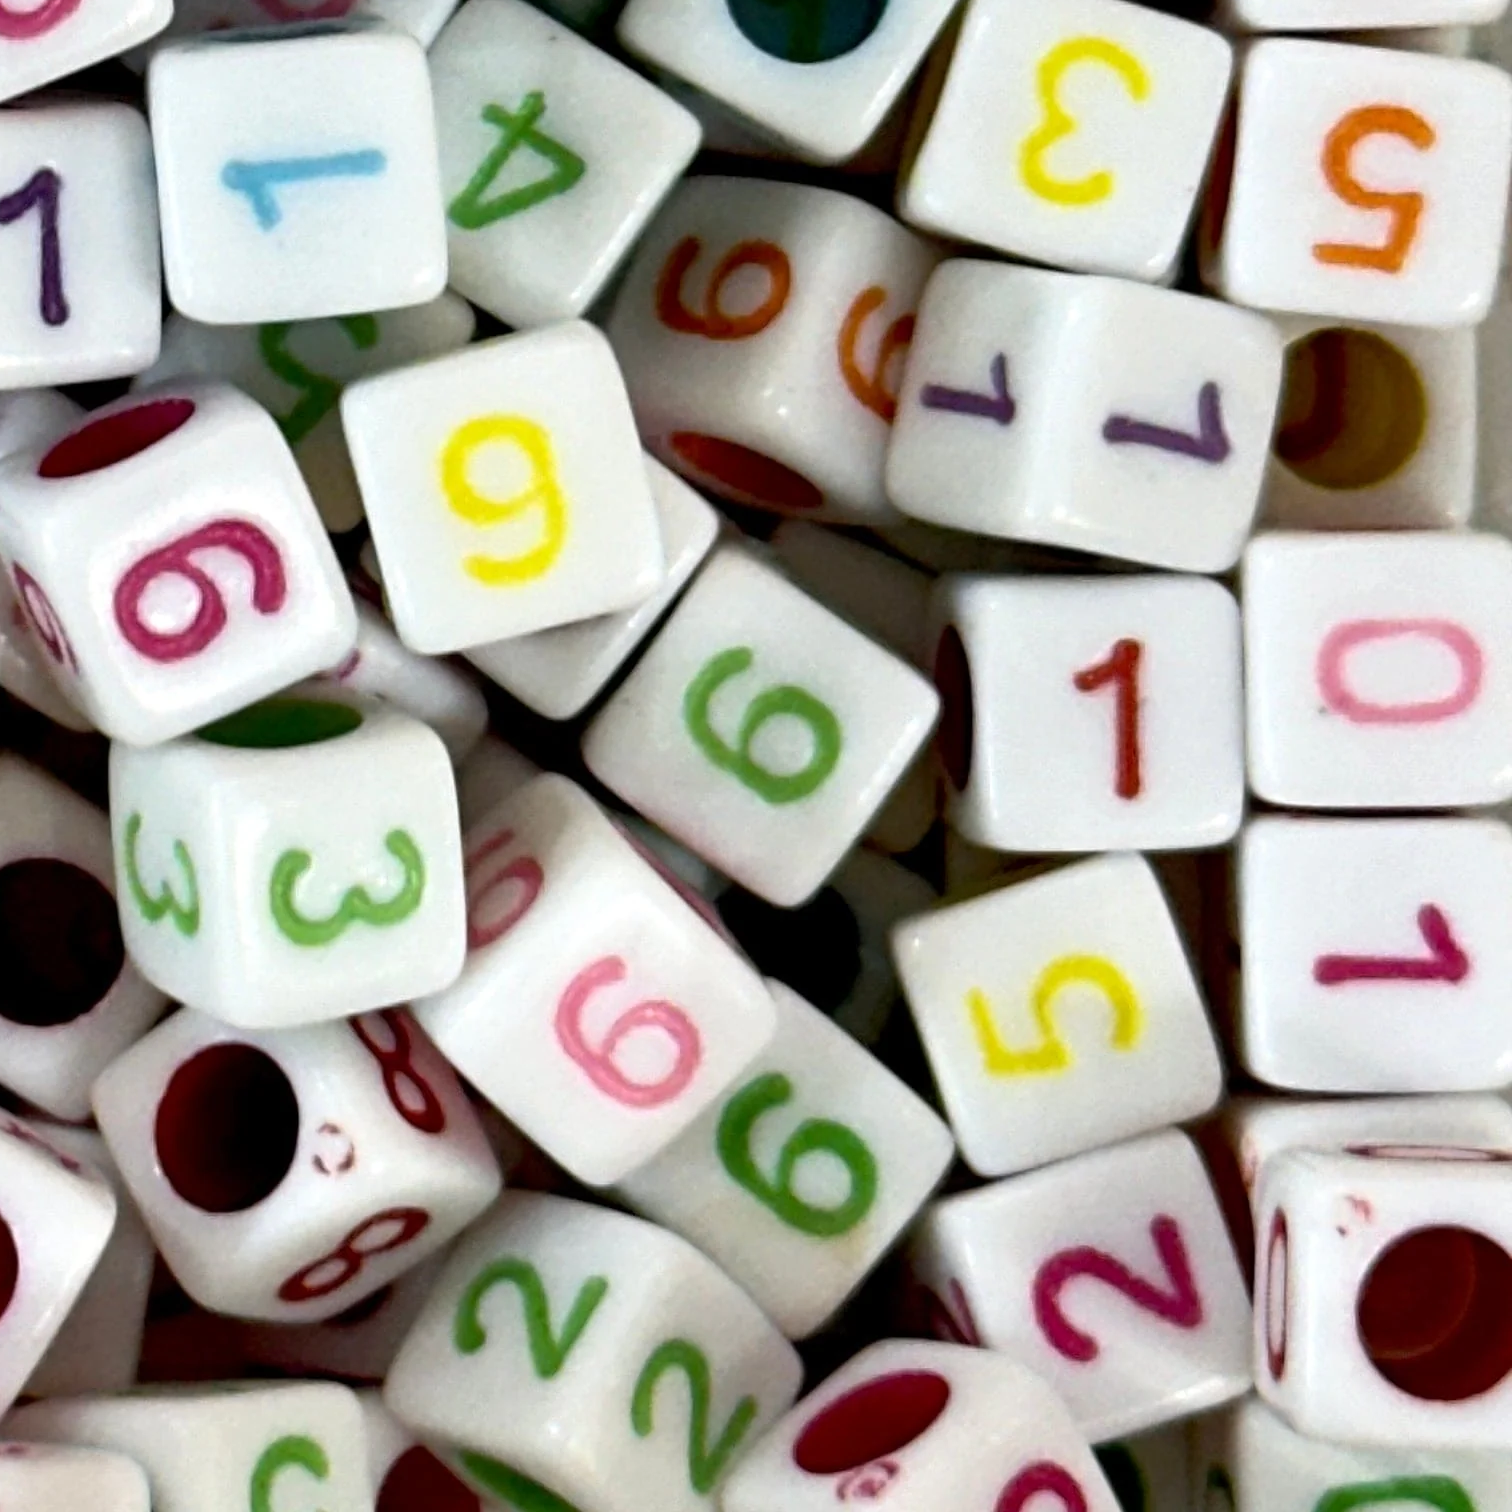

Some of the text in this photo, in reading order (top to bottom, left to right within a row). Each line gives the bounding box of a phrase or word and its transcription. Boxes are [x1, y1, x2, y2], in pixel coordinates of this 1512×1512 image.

[451, 93, 583, 229] 4
[1017, 35, 1152, 210] 3
[219, 149, 387, 235] 1
[1316, 106, 1434, 272] 5
[1101, 377, 1232, 465] 1
[687, 650, 840, 802] 6
[1073, 640, 1143, 799] 1
[1322, 625, 1480, 721] 0
[127, 818, 198, 934] 3
[271, 831, 425, 947] 3
[1313, 902, 1473, 987] 1
[558, 961, 697, 1104] 6
[965, 953, 1146, 1080] 5
[719, 1076, 877, 1239] 6
[281, 1211, 427, 1300] 8
[457, 1262, 604, 1377] 2
[1034, 1218, 1201, 1360] 2
[633, 1343, 754, 1492] 2
